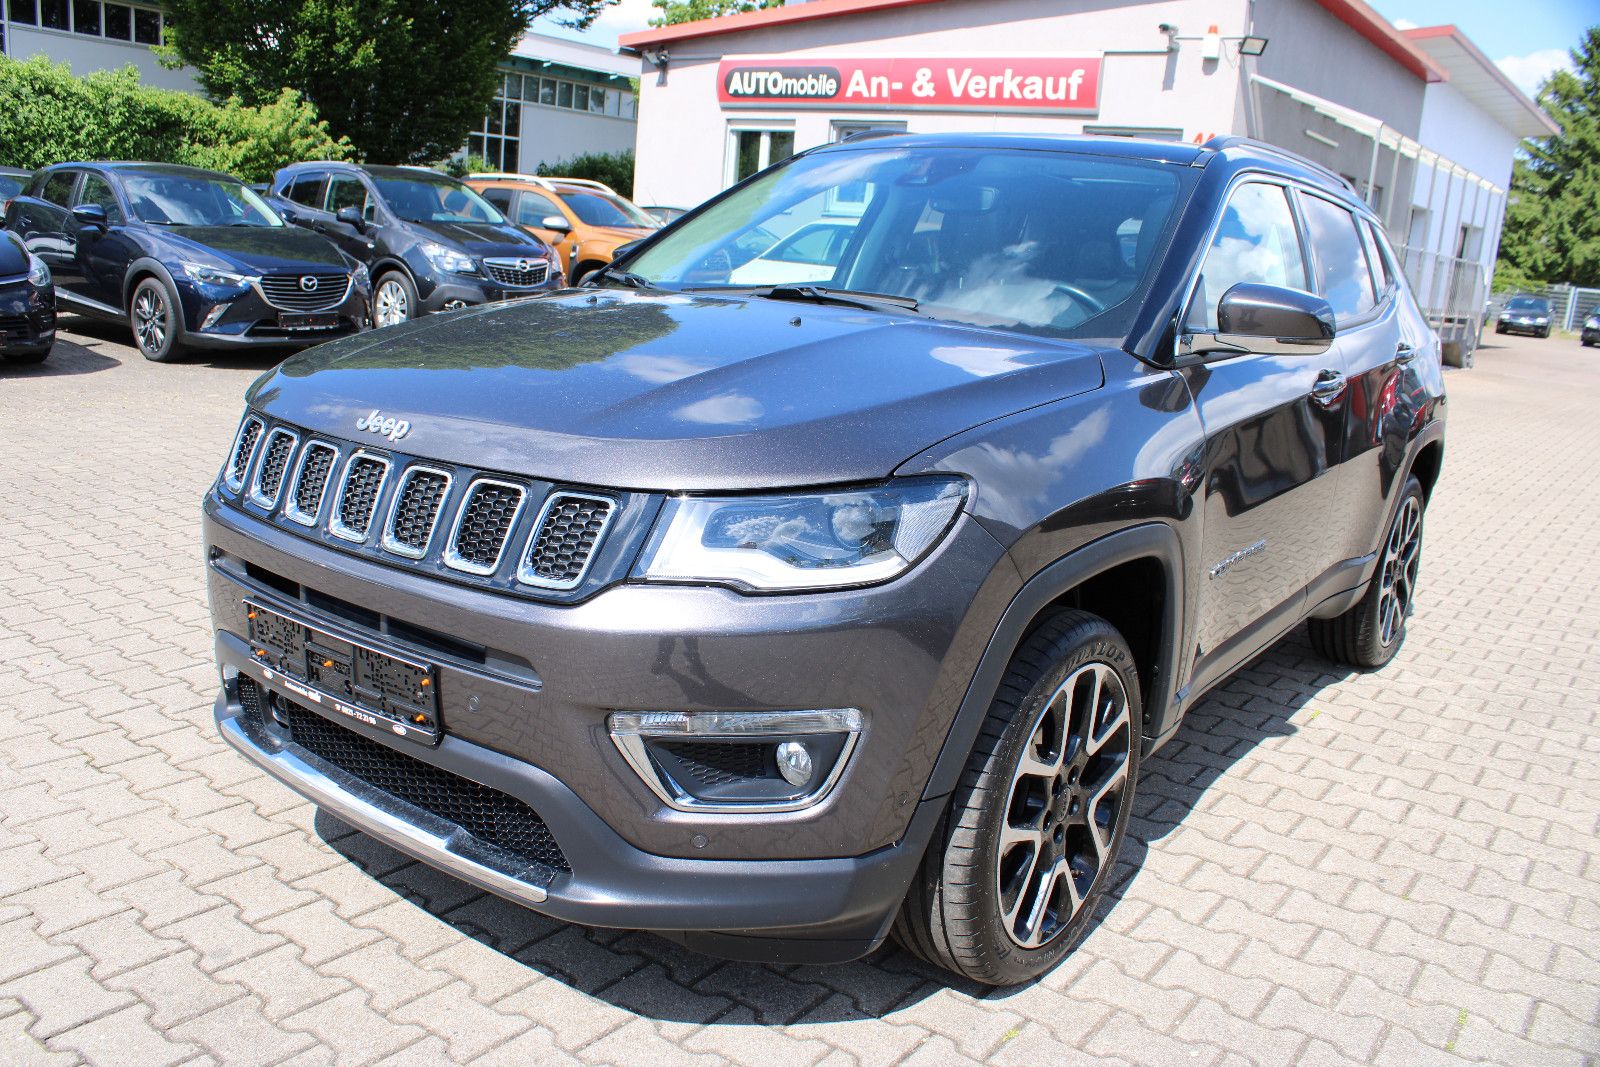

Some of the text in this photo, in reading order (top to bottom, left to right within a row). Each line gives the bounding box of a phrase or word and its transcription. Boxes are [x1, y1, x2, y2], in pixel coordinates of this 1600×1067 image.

[728, 67, 1086, 101] AUTOmobile An- & Verkauf
[356, 409, 412, 442] Jeep
